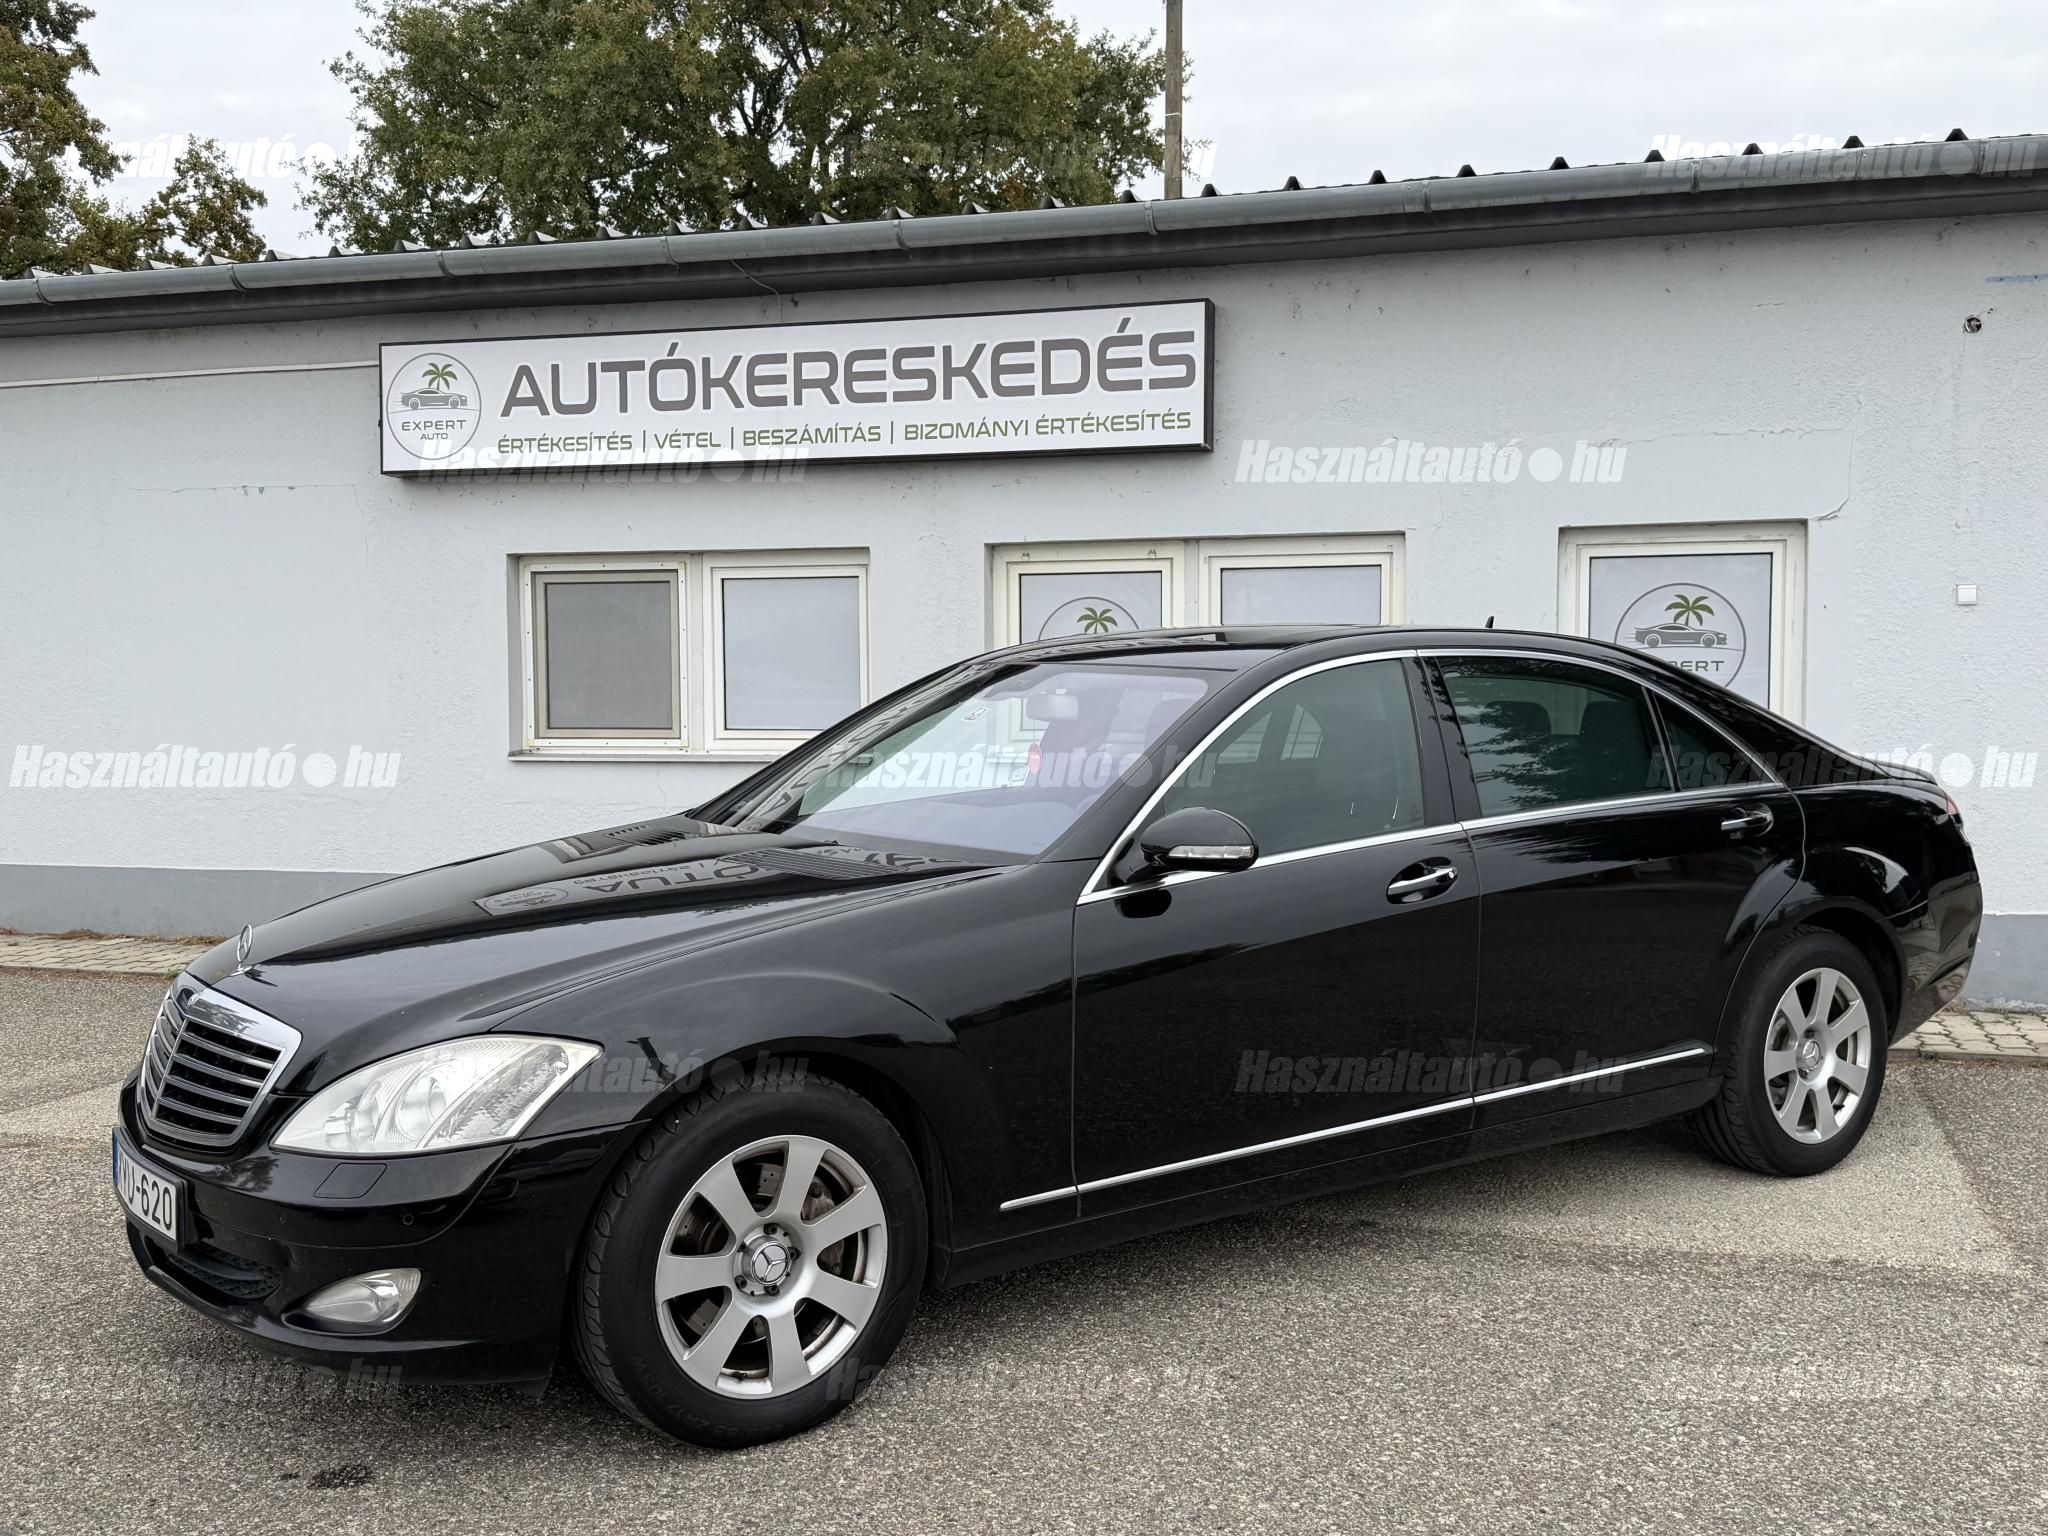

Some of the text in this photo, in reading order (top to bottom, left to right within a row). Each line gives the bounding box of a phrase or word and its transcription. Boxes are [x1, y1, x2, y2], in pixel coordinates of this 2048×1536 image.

[500, 317, 1197, 418] AUTÓKERESKEDÉS
[402, 419, 467, 431] EXPERT
[498, 408, 1191, 454] ÉRTÉKESÍTÉS VÉTEL BESZÁMÍTÁS BIZOMÁNYI ÉRTÉKESÍTÉS
[420, 432, 449, 440] AUTO
[1667, 660, 1725, 672] ERT
